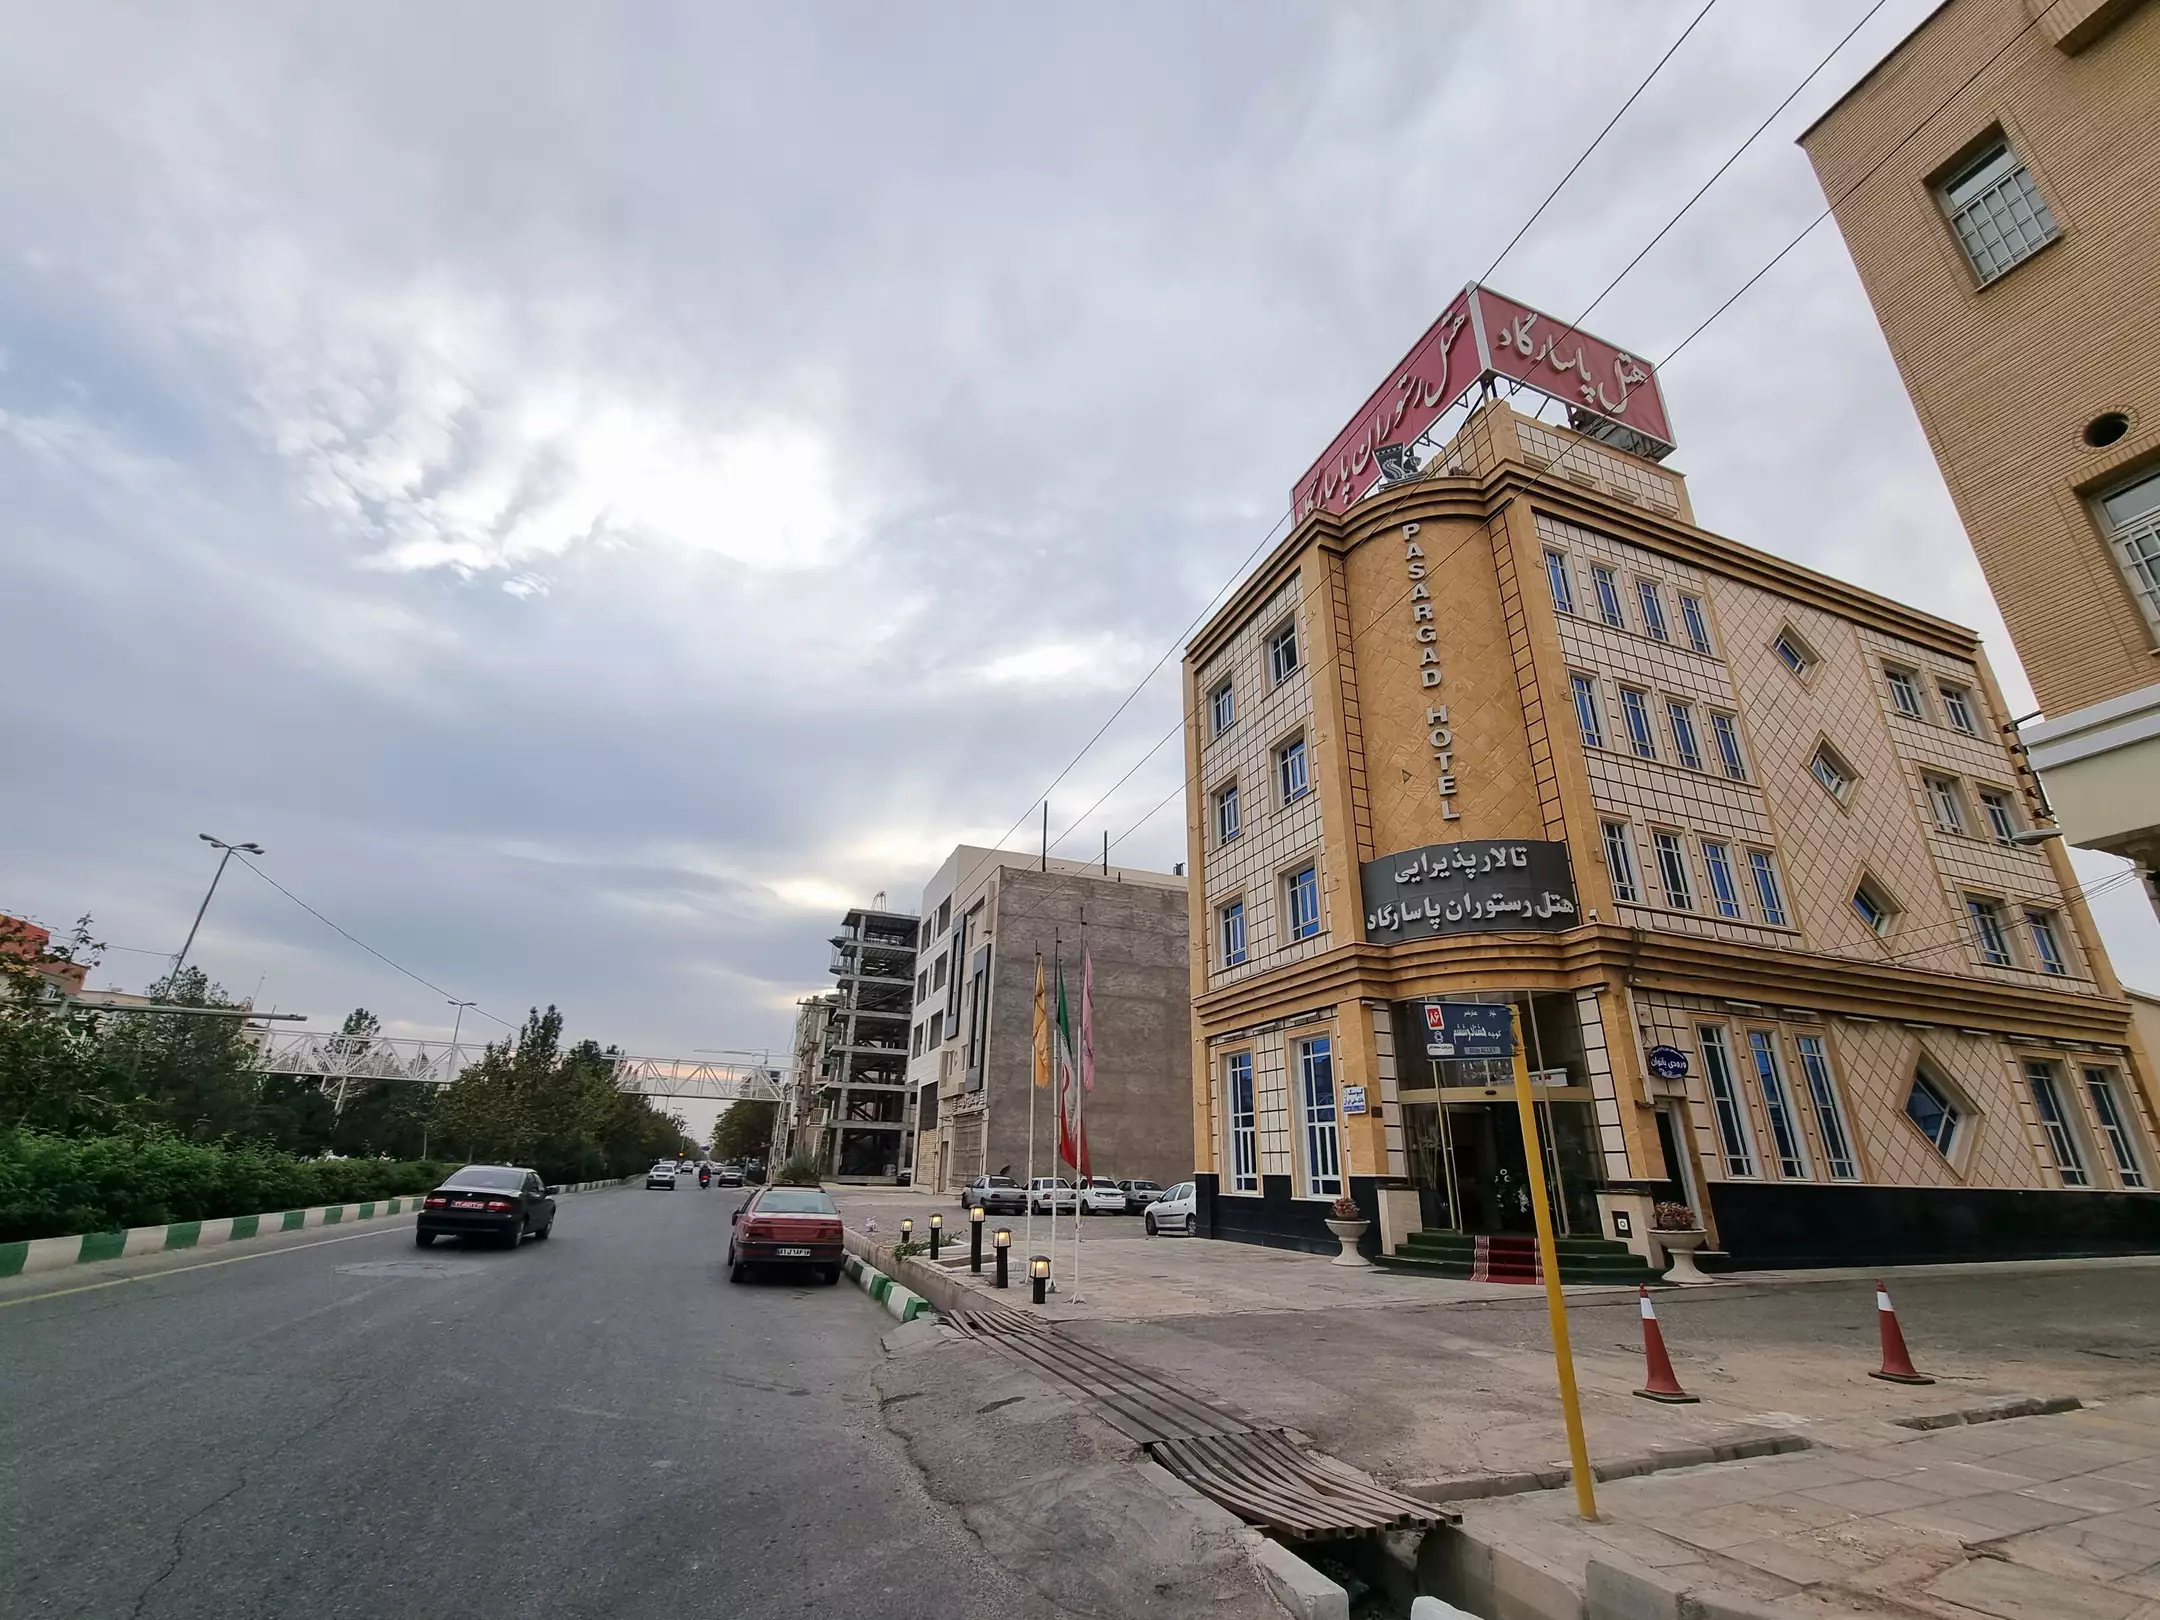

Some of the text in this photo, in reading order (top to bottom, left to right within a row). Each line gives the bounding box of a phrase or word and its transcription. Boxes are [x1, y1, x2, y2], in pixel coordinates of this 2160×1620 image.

[1424, 310, 1466, 408] هتل
[1497, 313, 1648, 414] هتل پاسارگاد
[1401, 523, 1460, 821] PASARGAD HOTEL
[1366, 891, 1574, 930] هتل رستوران پاسارگاد
[1394, 846, 1528, 884] تالار پذیرایی
